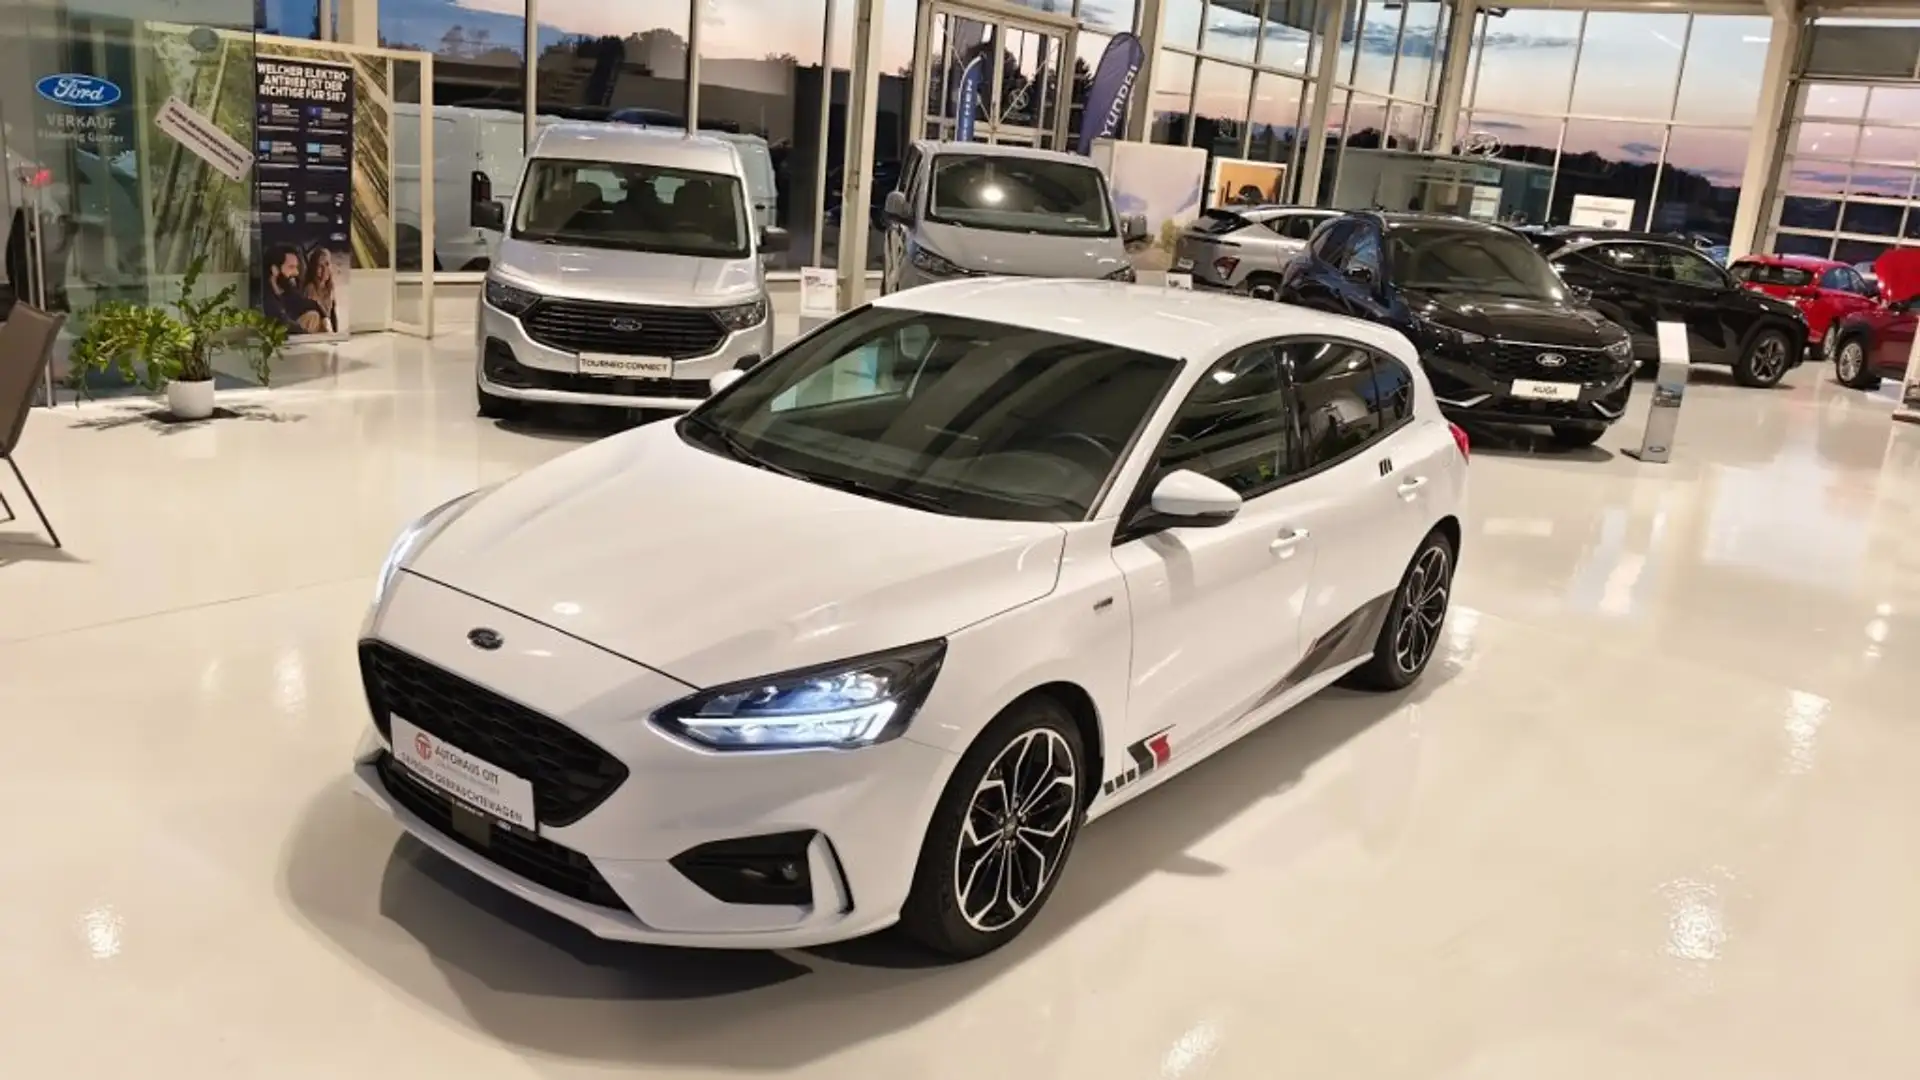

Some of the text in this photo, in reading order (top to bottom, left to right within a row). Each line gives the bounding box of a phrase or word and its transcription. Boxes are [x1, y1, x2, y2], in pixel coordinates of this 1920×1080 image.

[257, 62, 303, 77] WELCHER
[54, 79, 105, 100] Ford
[264, 74, 343, 91] ANTRIEB IST DER
[259, 85, 305, 98] RICHTIGE
[326, 90, 347, 102] SIE?
[1100, 64, 1138, 137] YUNDAI
[46, 112, 117, 129] VERKAUF
[581, 358, 668, 372] TOURNEO CONNECT
[1532, 386, 1558, 394] KUGA
[435, 745, 480, 776] AUTOHAUS
[482, 768, 499, 785] OTT
